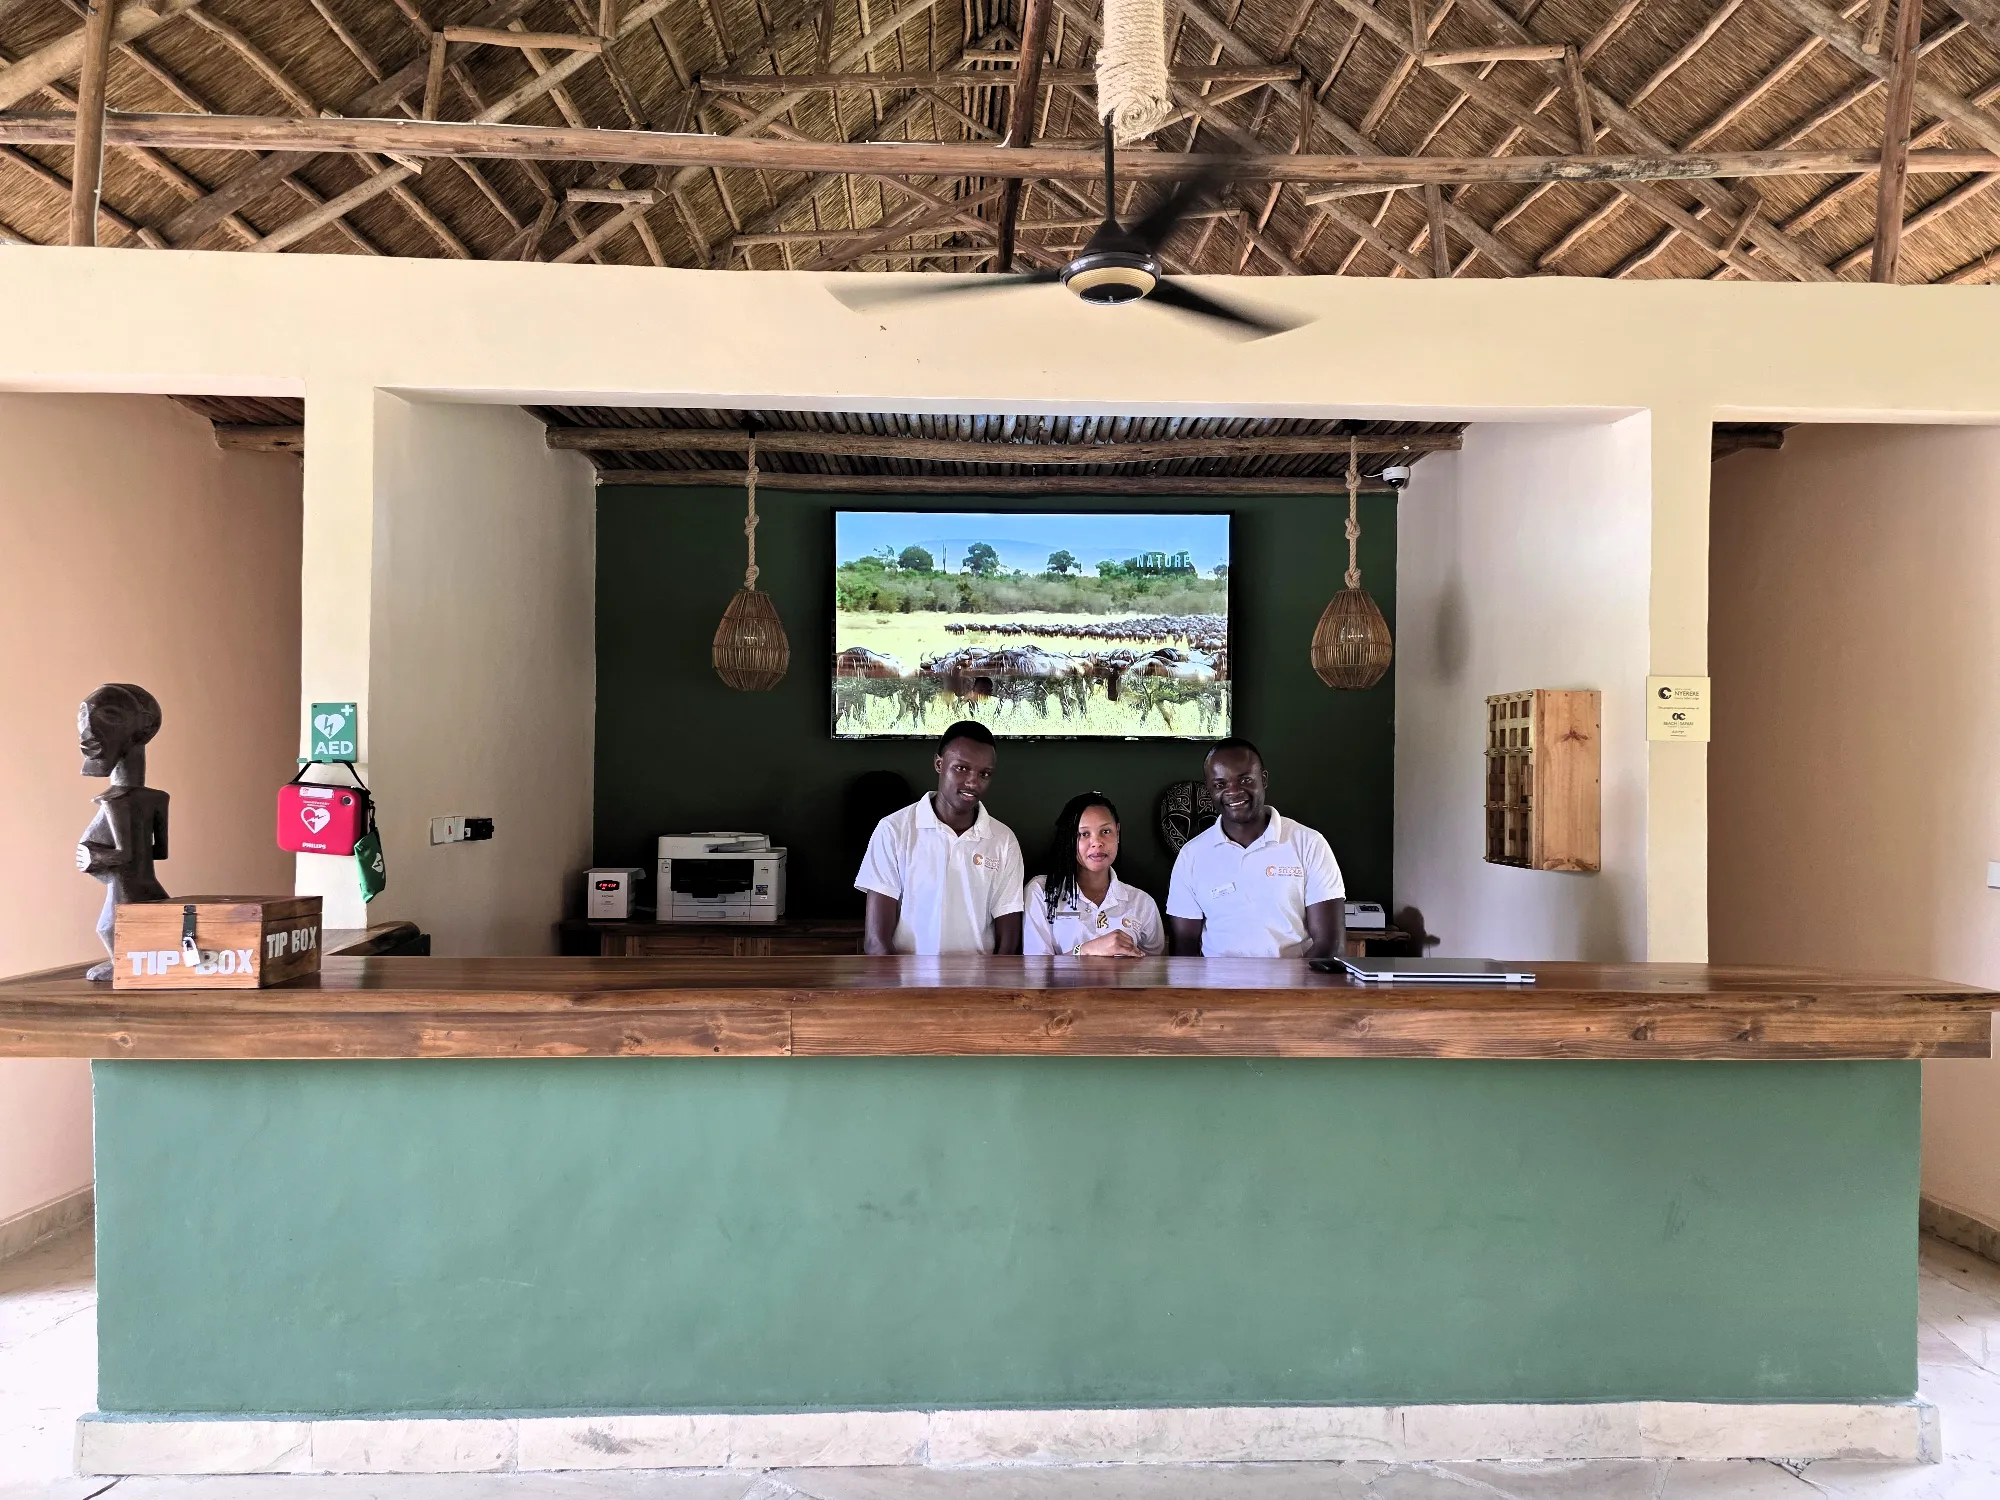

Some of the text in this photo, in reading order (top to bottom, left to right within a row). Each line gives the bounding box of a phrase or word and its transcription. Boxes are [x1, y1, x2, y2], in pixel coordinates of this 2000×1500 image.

[1136, 554, 1190, 568] NATURE
[314, 740, 354, 756] AED
[302, 841, 327, 850] PHILIPS
[266, 926, 317, 959] TIP BOX
[127, 949, 254, 976] TIP BOX
